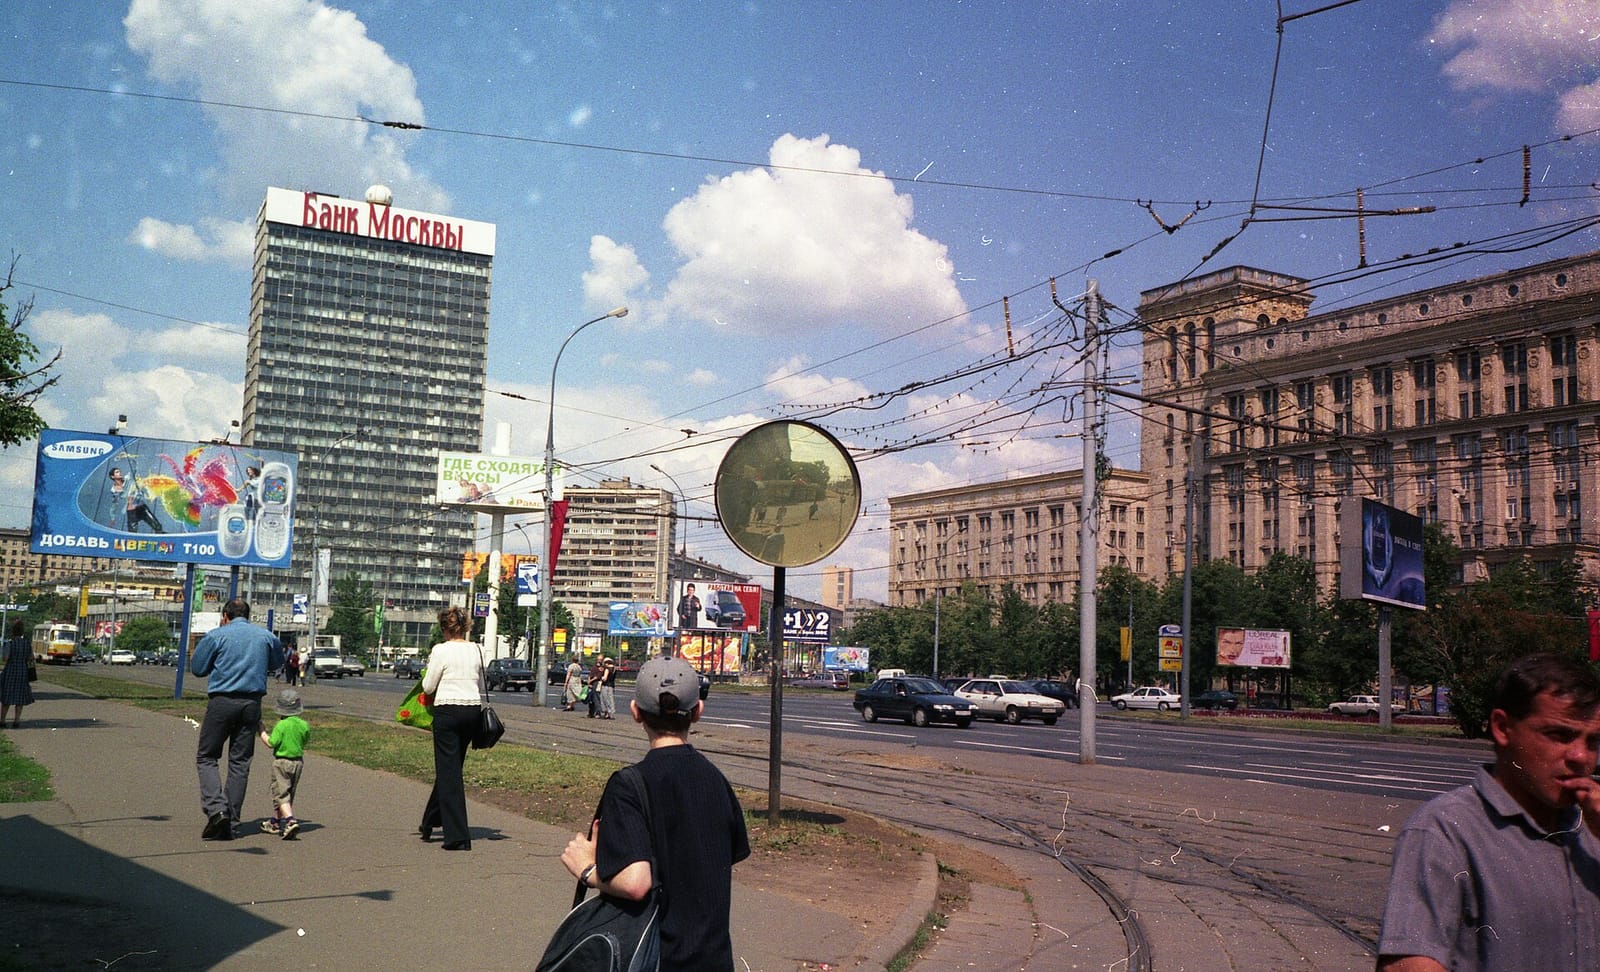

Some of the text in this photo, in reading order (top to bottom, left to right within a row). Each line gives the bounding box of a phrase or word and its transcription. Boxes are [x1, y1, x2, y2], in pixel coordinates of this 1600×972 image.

[303, 192, 463, 251] Банк Москвы
[51, 443, 105, 455] SAMSUNG
[444, 458, 472, 471] ГДЕ
[443, 470, 500, 483] ВКУСЫ
[516, 499, 544, 507] Рамс
[40, 534, 109, 548] ДОБАВЬ
[184, 543, 216, 556] T100
[816, 611, 829, 630] 2
